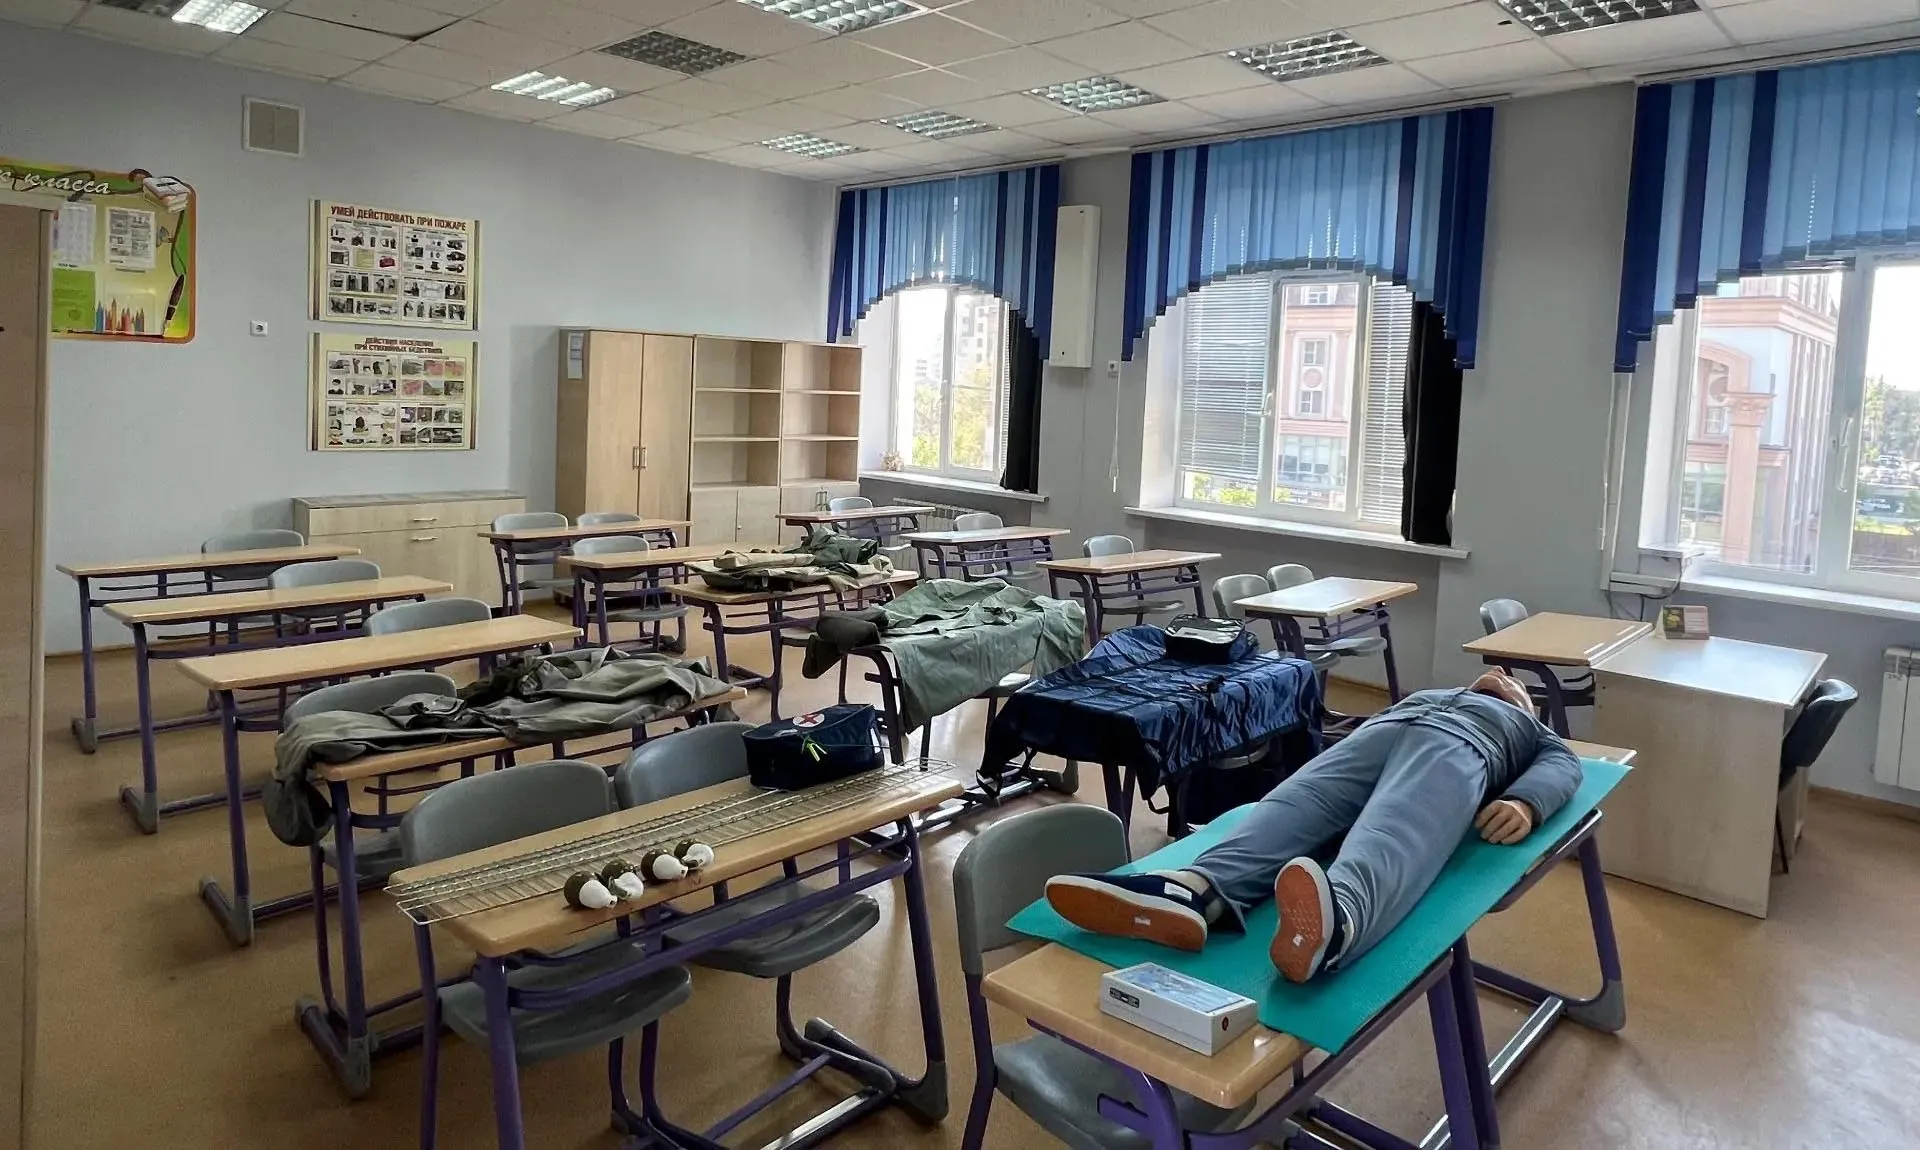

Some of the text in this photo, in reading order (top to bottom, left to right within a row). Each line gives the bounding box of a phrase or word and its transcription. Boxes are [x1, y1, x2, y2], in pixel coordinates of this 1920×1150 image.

[24, 173, 110, 194] класса
[331, 205, 354, 217] УМЕЙ
[357, 209, 415, 224] ДЕЙСТВОВАТЬ
[417, 216, 432, 227] ПРИ
[435, 218, 466, 231] ПОЖАРЕ
